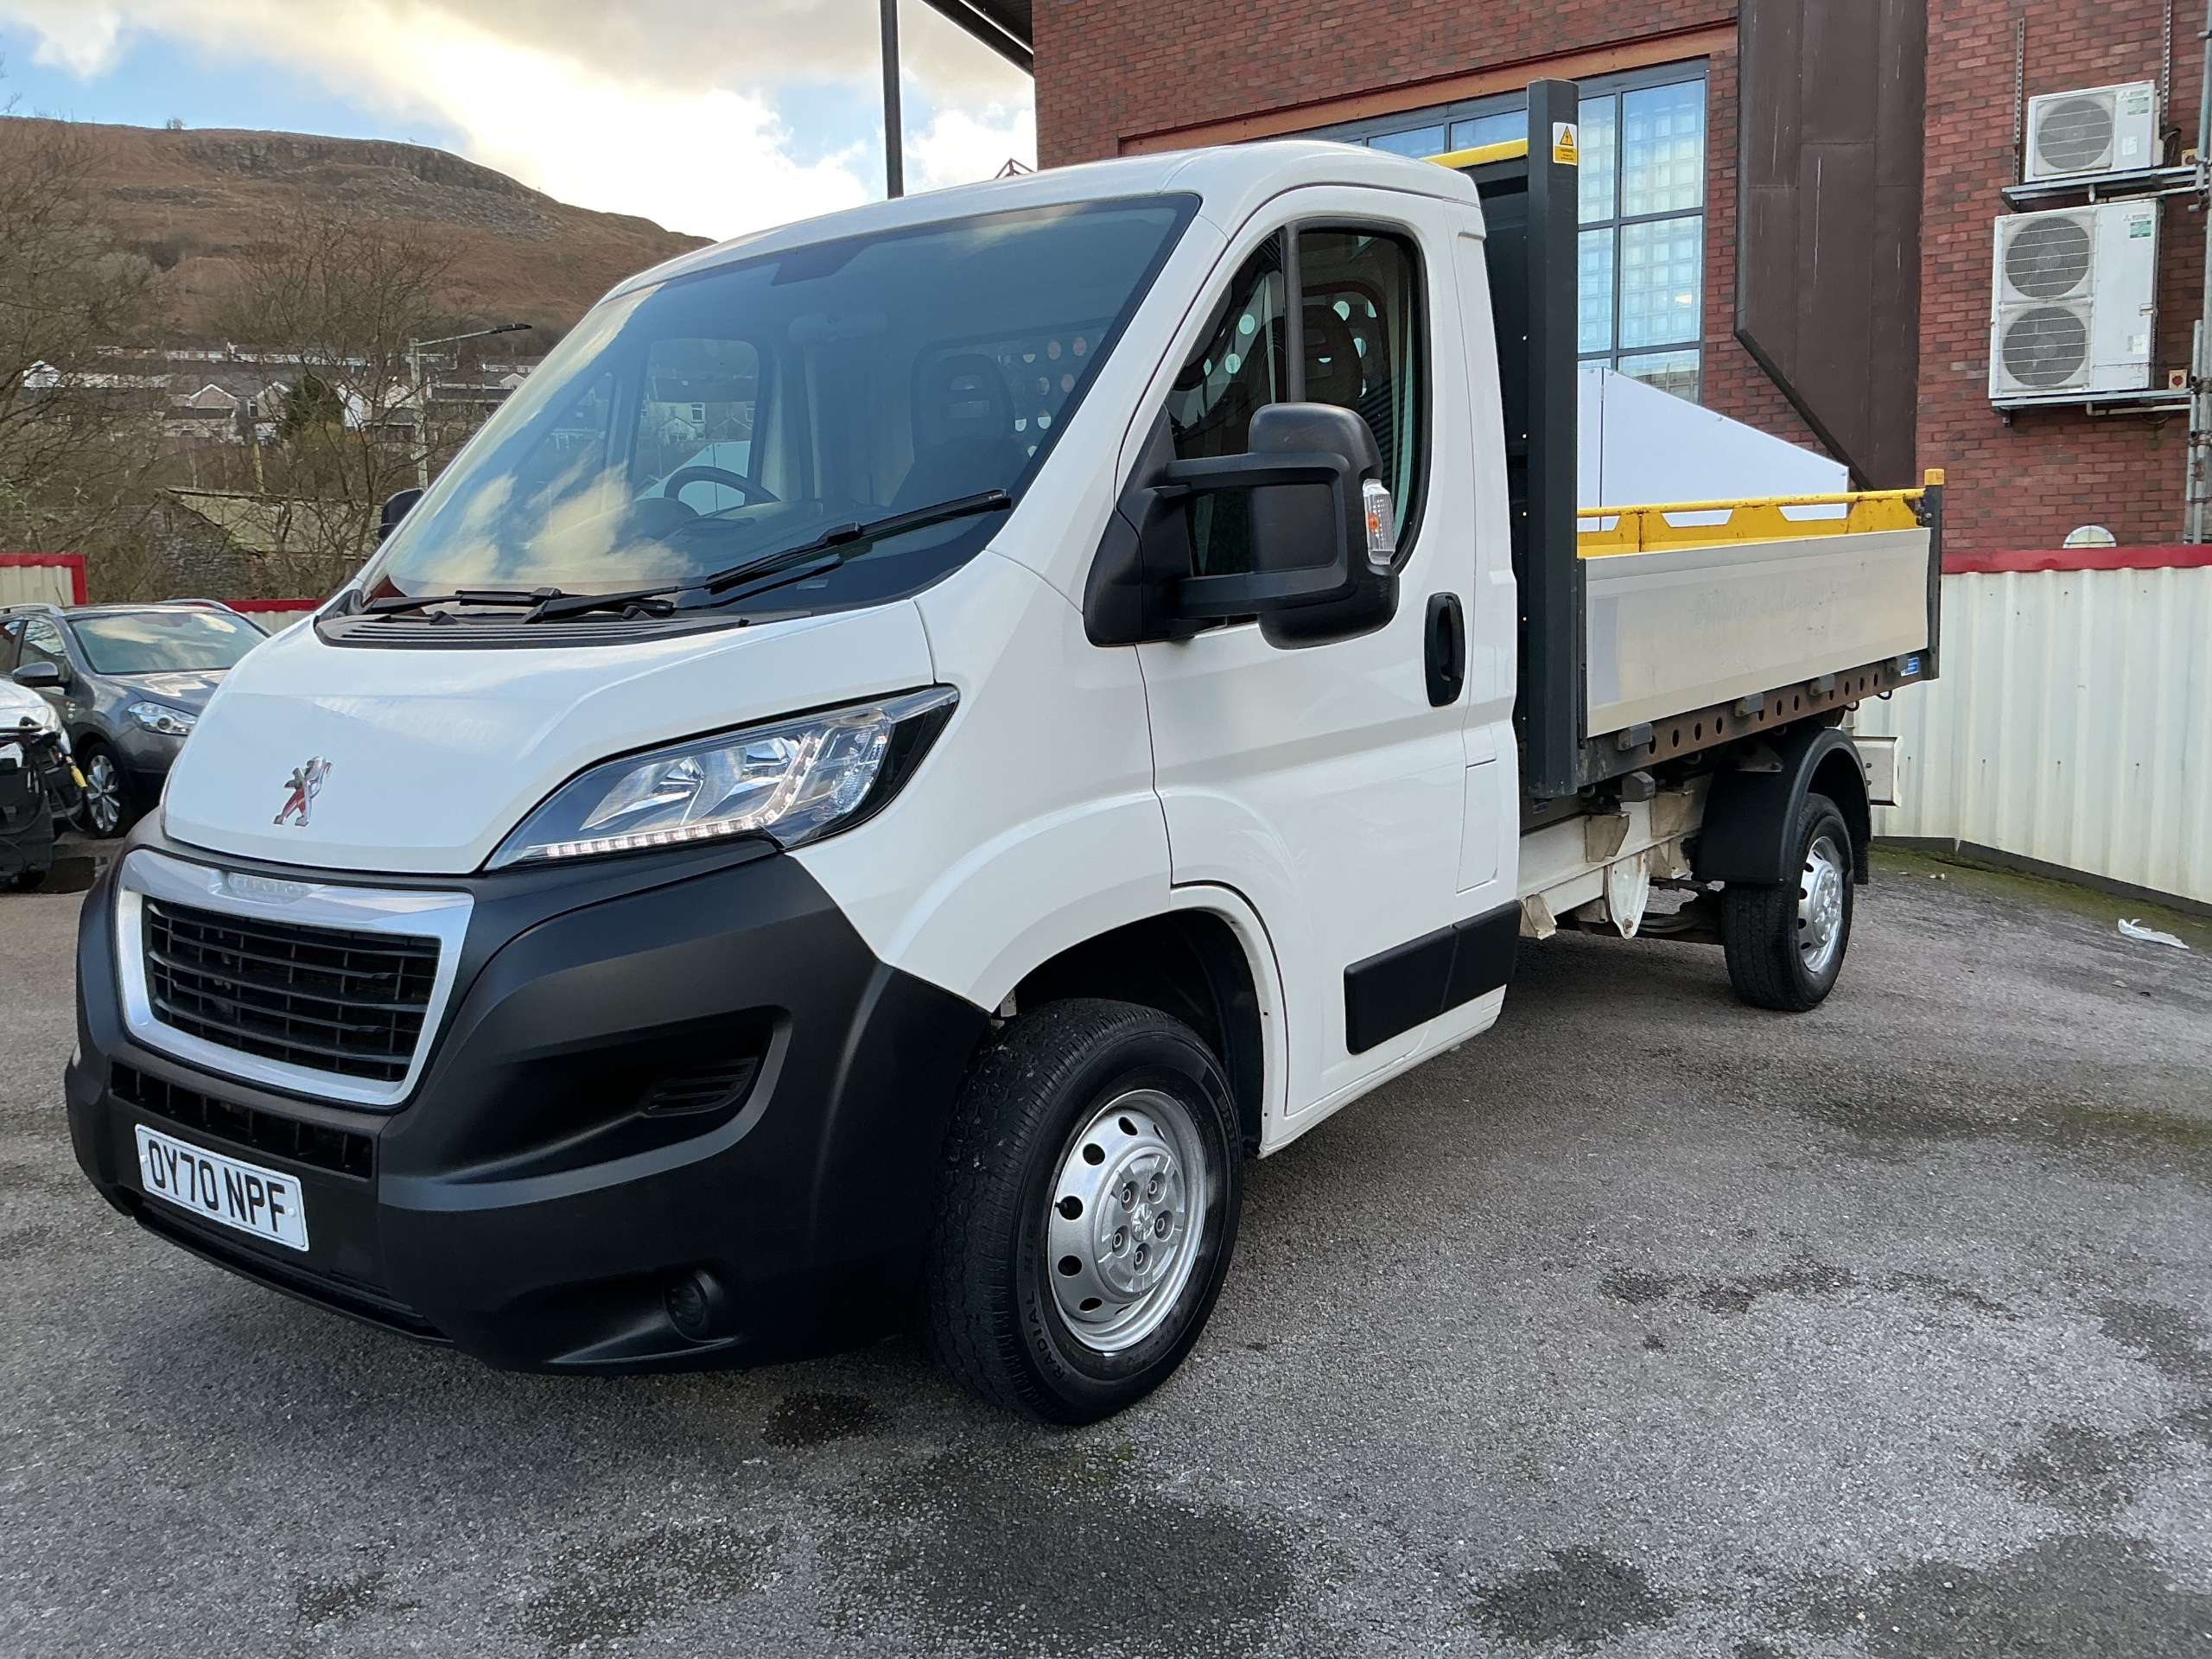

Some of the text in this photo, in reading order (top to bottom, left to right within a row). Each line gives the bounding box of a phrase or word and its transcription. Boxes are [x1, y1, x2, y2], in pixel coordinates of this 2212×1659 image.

[148, 1139, 286, 1233] OY70 NPF
[1026, 1290, 1065, 1380] RADIAL
